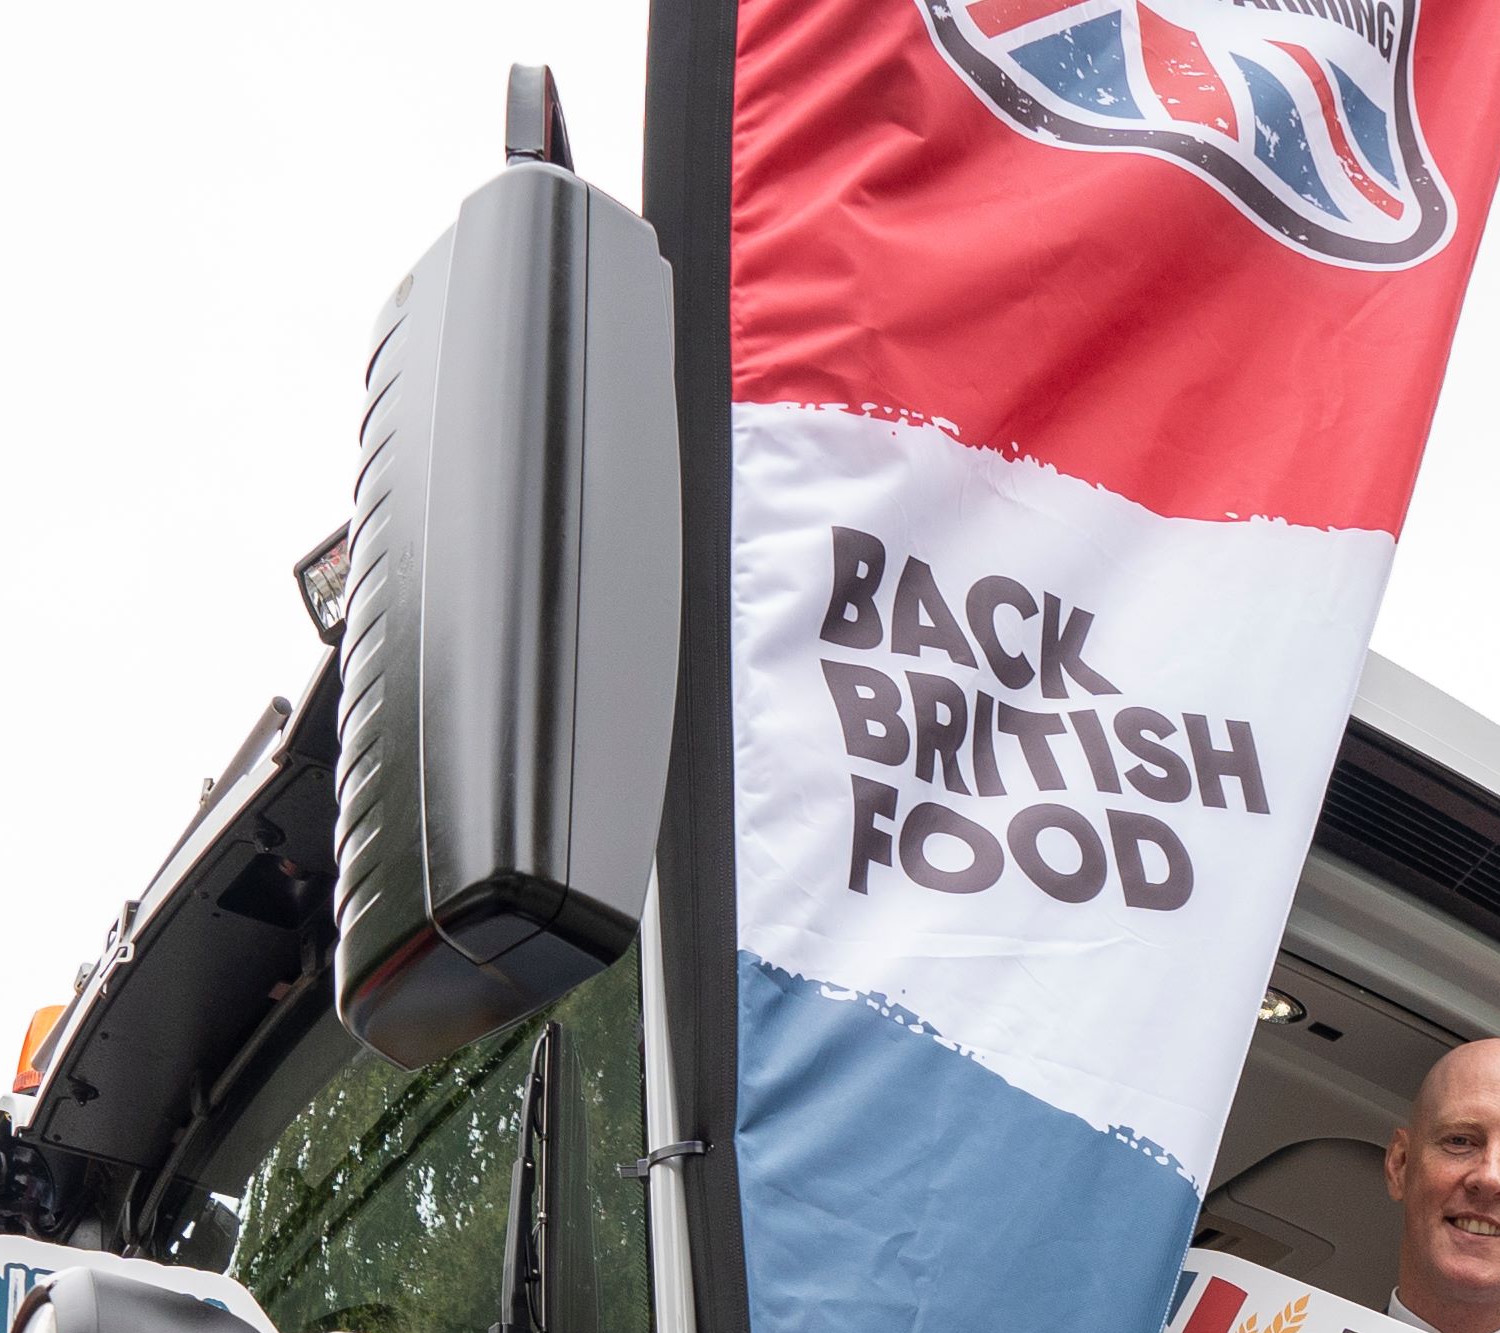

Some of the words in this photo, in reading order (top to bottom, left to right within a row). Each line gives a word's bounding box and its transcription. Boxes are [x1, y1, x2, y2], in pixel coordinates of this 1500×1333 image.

[819, 526, 1121, 698] BACK
[820, 660, 1270, 814] BRITISH
[848, 775, 1195, 911] FOOD
